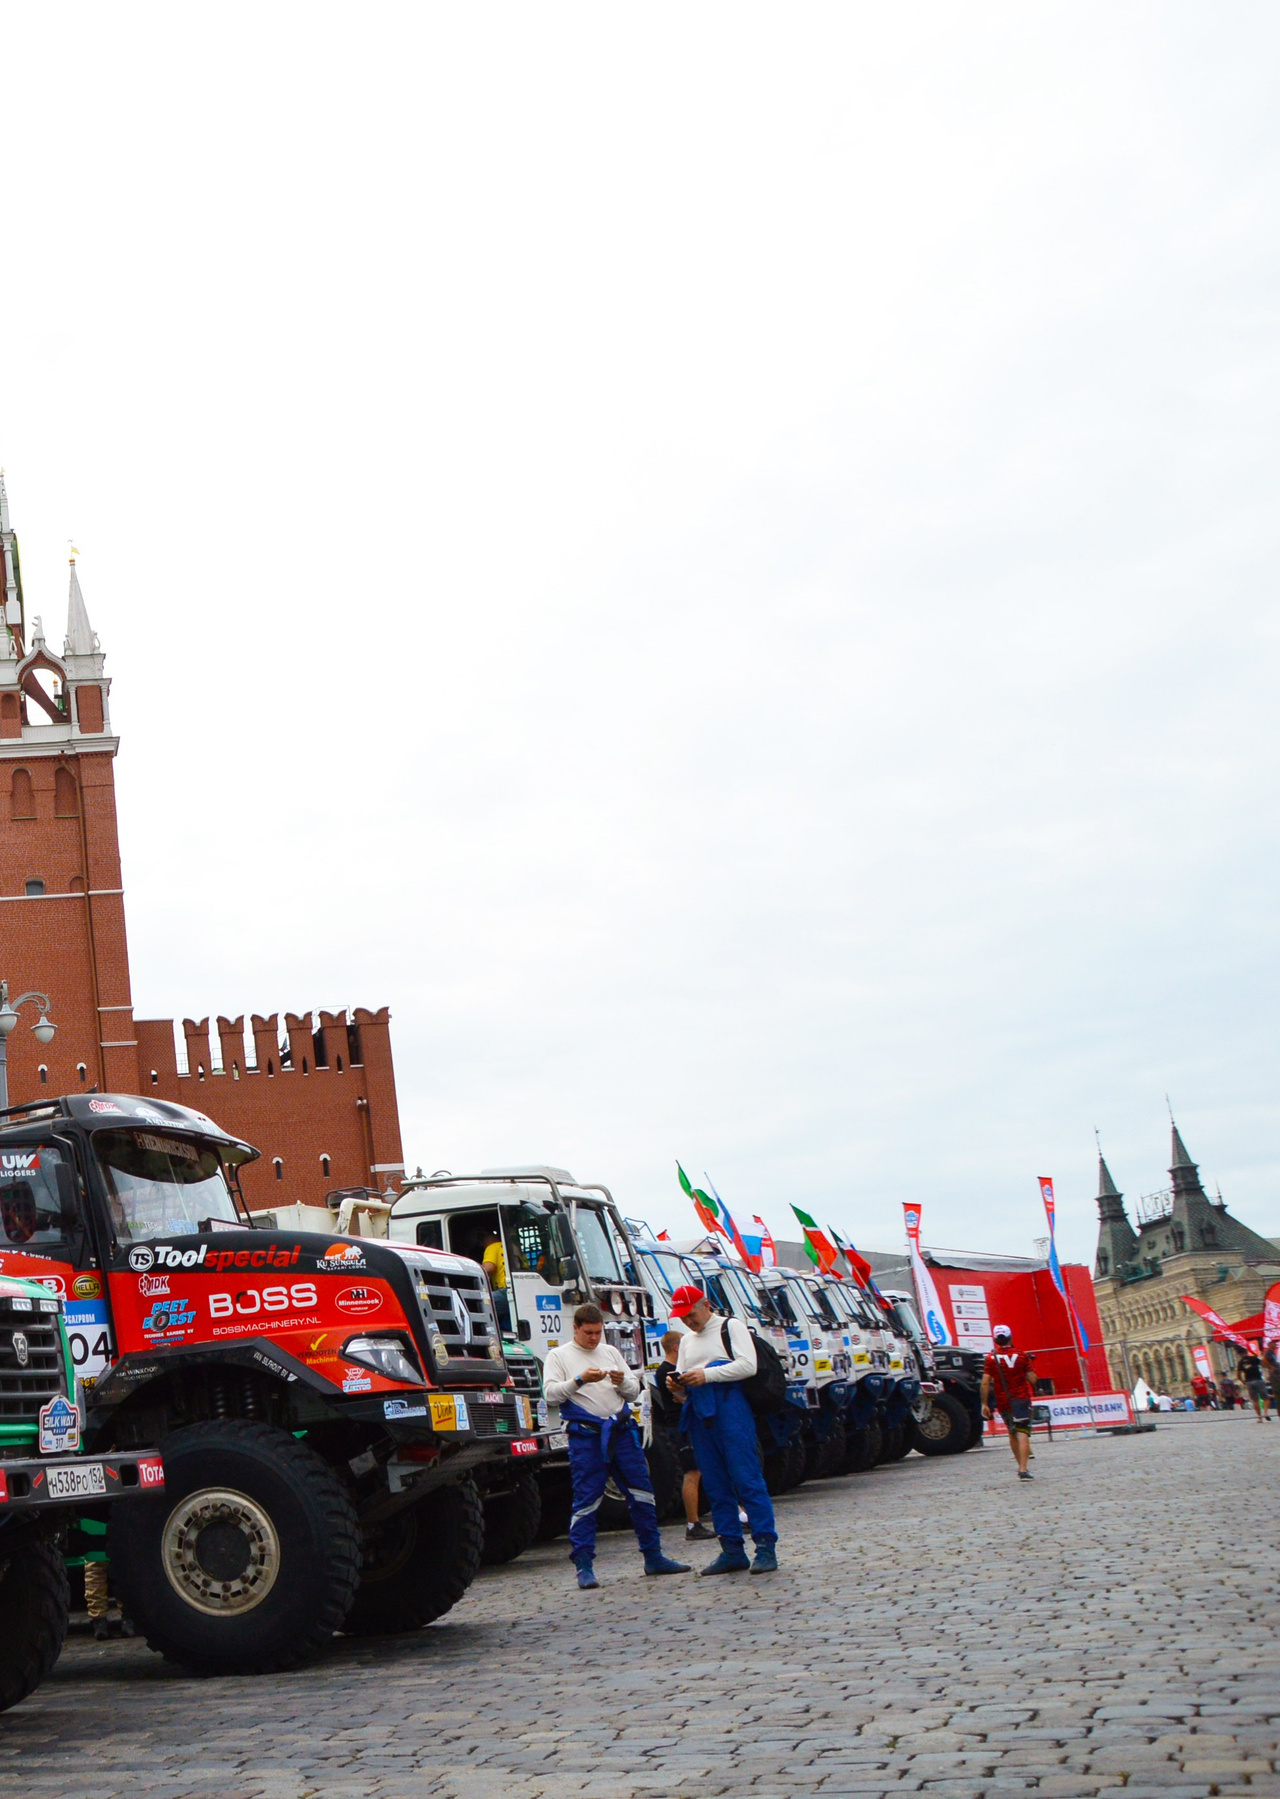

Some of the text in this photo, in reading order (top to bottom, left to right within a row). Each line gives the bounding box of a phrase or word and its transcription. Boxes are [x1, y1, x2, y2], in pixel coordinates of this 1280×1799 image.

[133, 1244, 300, 1271] TS Toolspecial
[316, 1260, 328, 1270] KU
[75, 1280, 100, 1292] HELLA
[151, 1299, 189, 1314] PEET
[208, 1283, 317, 1318] BOSS
[67, 1314, 96, 1324] GAZPROM
[213, 1316, 322, 1335] BOSSMACHINERY.NL
[540, 1314, 561, 1334] 320
[253, 1351, 262, 1361] VAN
[306, 1356, 338, 1365] Machines
[434, 1402, 453, 1419] Vink
[1052, 1402, 1124, 1418] GAZPROMBANK
[44, 1415, 75, 1428] SILK WAY
[55, 1438, 63, 1449] 317
[513, 1441, 538, 1453] TOTAL
